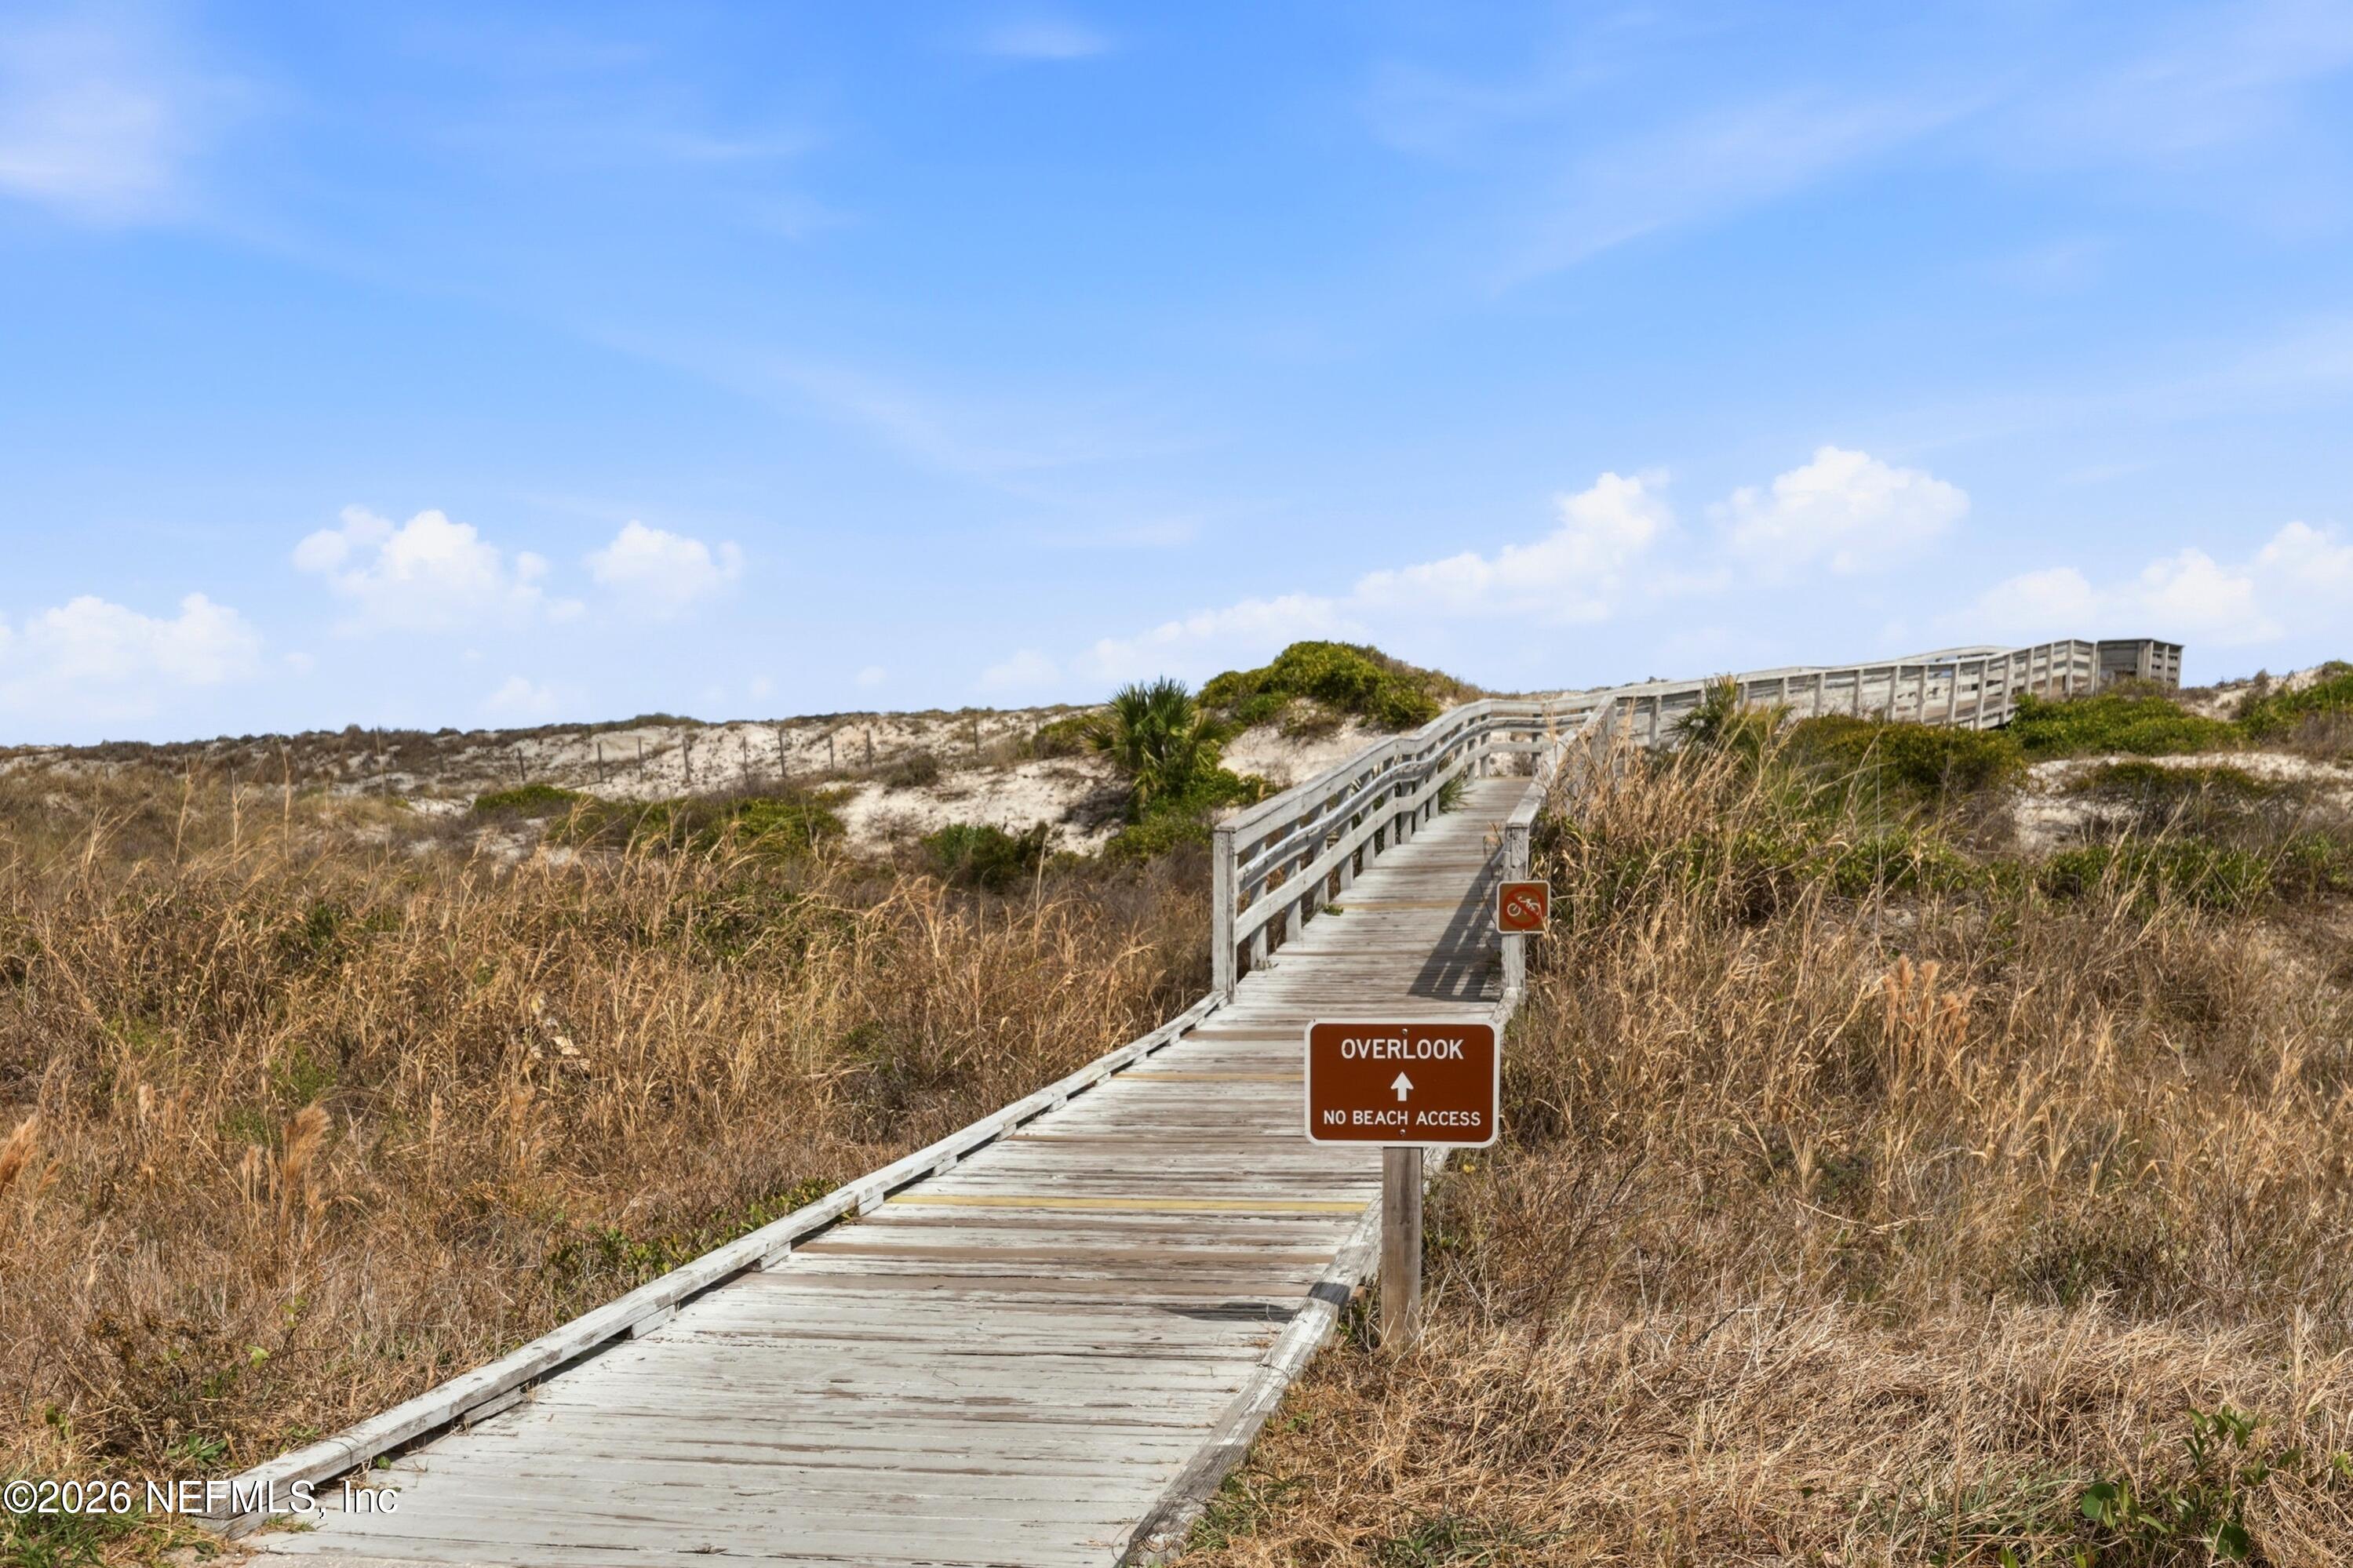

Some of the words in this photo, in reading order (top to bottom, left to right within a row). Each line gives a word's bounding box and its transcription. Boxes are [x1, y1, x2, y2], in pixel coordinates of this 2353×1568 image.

[1341, 1039, 1464, 1060] OVERLOOK
[1324, 1110, 1346, 1126] NO
[1353, 1110, 1408, 1126] BEACH
[1415, 1111, 1481, 1126] ACCESS
